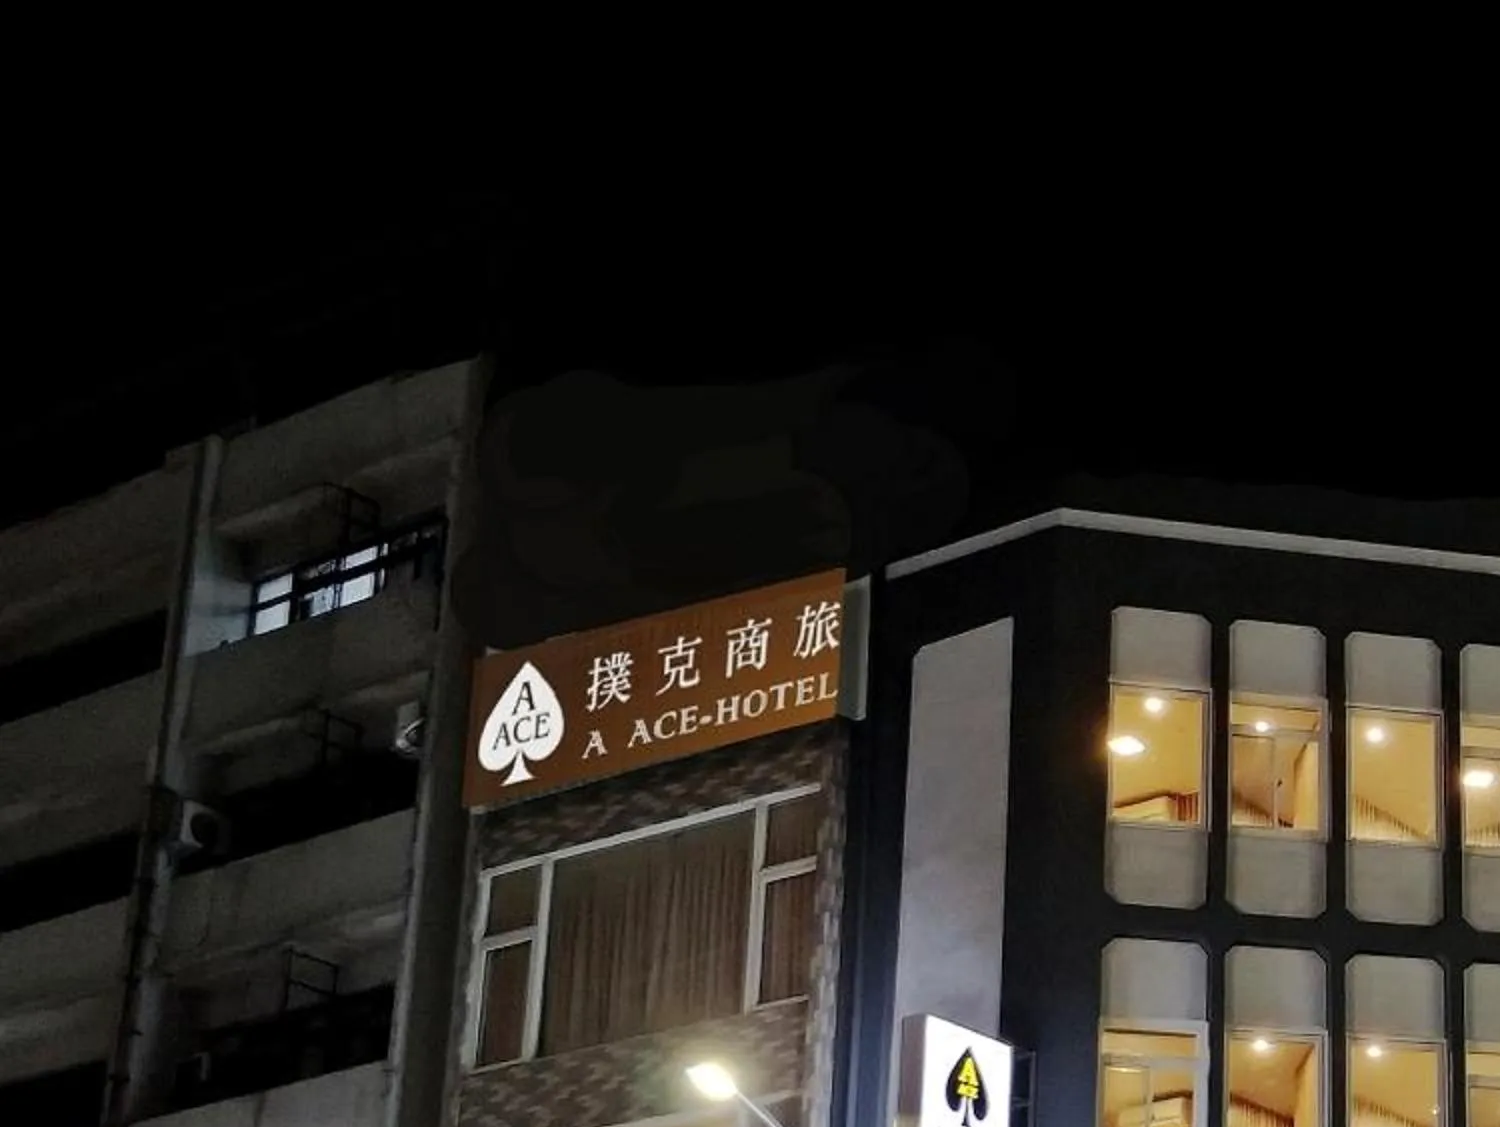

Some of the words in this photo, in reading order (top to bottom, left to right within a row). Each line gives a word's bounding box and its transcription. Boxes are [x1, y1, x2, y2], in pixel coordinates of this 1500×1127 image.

[585, 601, 841, 712] 撲克商旅
[511, 682, 536, 717] A
[581, 731, 606, 760] A
[627, 672, 839, 749] ACE-HOTEL
[492, 714, 551, 751] ACE
